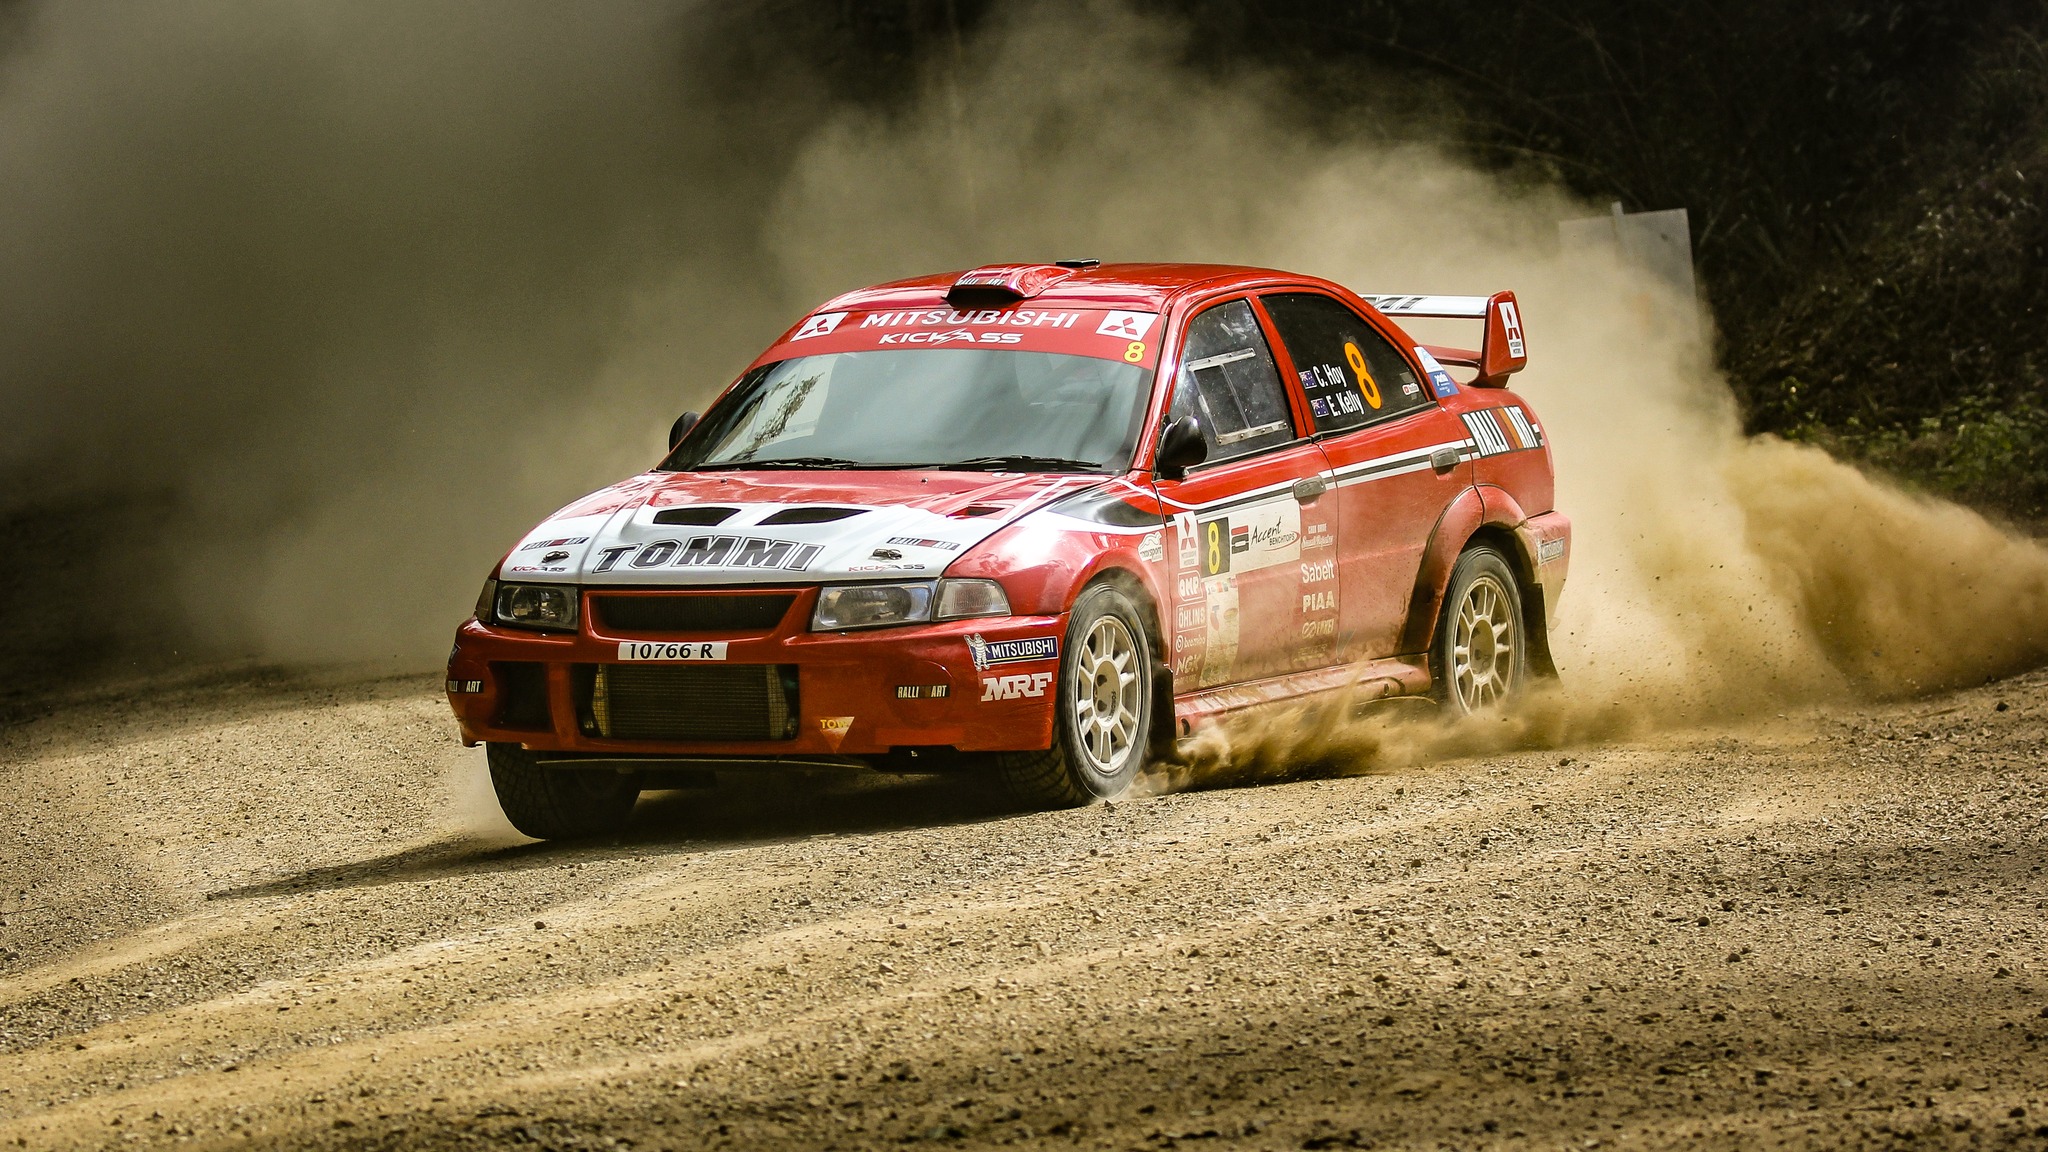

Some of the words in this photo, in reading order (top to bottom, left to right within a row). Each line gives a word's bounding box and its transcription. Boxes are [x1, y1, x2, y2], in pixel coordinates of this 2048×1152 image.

[859, 310, 1080, 329] MITSUBISHI
[878, 327, 1024, 346] KICKASS
[1123, 341, 1147, 363] 8
[1312, 365, 1329, 388] C.
[1322, 363, 1347, 388] Hoy
[1344, 342, 1382, 410] 8
[1325, 395, 1342, 417] E.
[1335, 389, 1365, 415] Kelly
[1461, 408, 1511, 457] RALLI
[1251, 516, 1282, 546] Accent
[1268, 533, 1296, 546] BENCHTOPS
[592, 534, 826, 574] TOMMI
[1208, 521, 1221, 575] 8
[1301, 559, 1335, 584] Sabelt
[1303, 590, 1335, 613] PIAA
[991, 640, 1055, 659] MITSUBISHI
[465, 681, 481, 693] ART
[897, 686, 920, 699] RALLI
[930, 685, 948, 698] ART
[981, 672, 1053, 702] MRF
